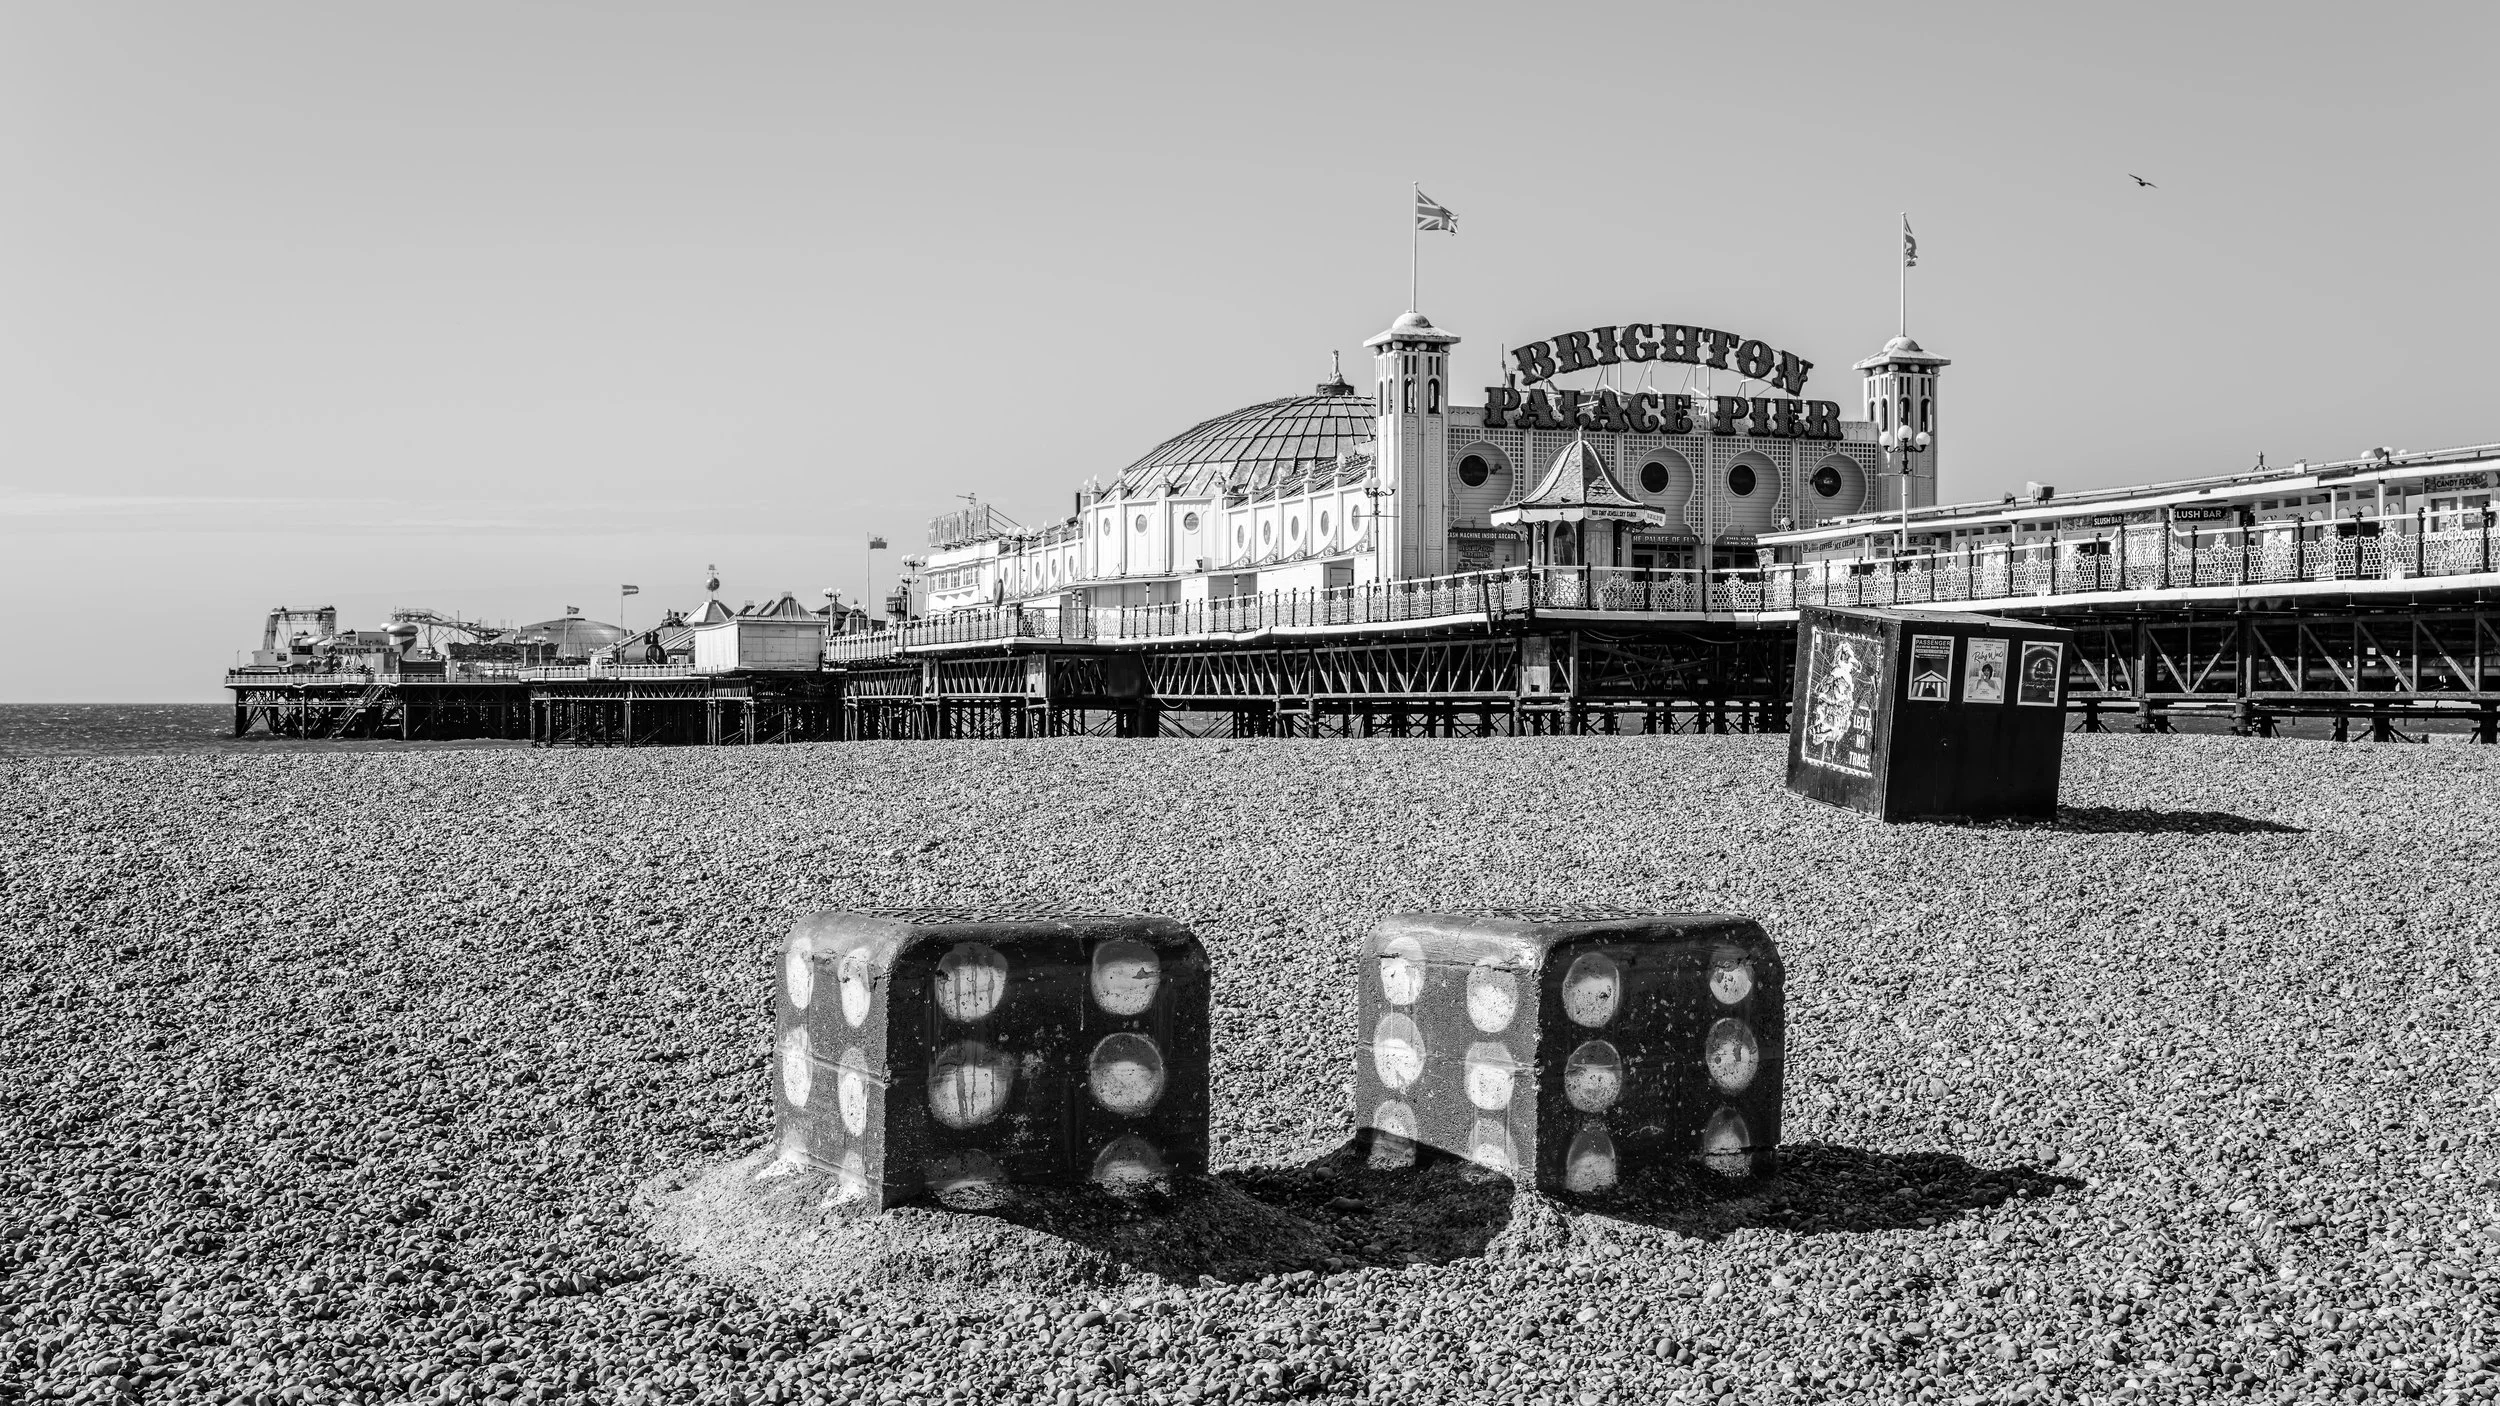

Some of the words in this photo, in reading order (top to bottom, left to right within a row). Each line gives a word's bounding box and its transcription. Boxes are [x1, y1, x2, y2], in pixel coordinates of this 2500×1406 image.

[1511, 323, 1814, 396] BRIGHTON
[1484, 386, 1693, 434] PALACE
[1713, 395, 1844, 440] PIER
[2436, 479, 2458, 488] CANDY
[2459, 477, 2478, 485] FLOSS
[2094, 516, 2111, 526] SLUSH
[2111, 515, 2122, 524] BAR
[2203, 510, 2222, 518] BAR
[1819, 540, 1833, 551] COFFEE
[1841, 537, 1856, 548] CREAM
[1915, 639, 1951, 647] PASSENGER
[1856, 733, 1866, 750] NO
[1849, 750, 1870, 769] TRACE
